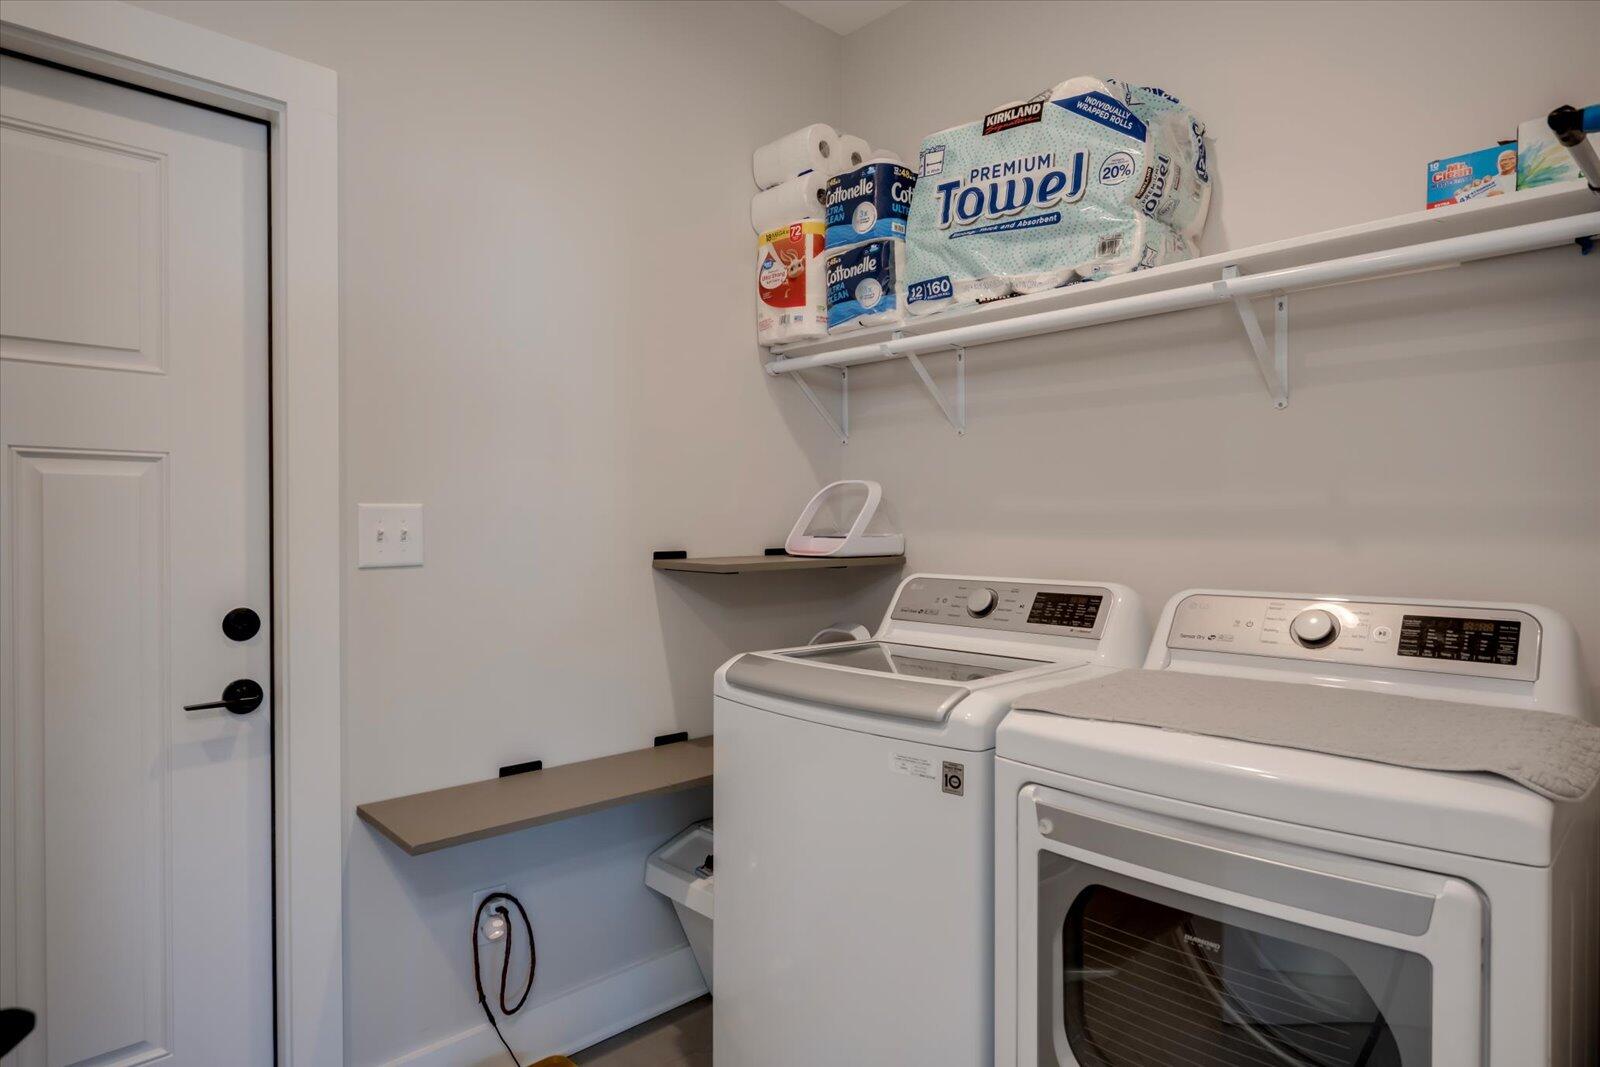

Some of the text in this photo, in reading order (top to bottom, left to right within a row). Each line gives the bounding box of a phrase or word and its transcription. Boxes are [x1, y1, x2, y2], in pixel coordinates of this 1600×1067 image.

[986, 103, 1041, 127] KIRKLAND
[1076, 101, 1133, 130] WRAPPED ROLLS
[1084, 96, 1131, 119] INDIVIDUALLY
[970, 153, 1051, 183] PREMIUM
[1102, 163, 1131, 180] 20%
[825, 178, 874, 208] Cottonelle
[936, 151, 1085, 226] Towel
[791, 225, 802, 237] 72
[1017, 214, 1057, 228] Absorbent
[827, 256, 877, 286] Cottonelle
[911, 286, 923, 298] 12
[927, 279, 950, 296] 160
